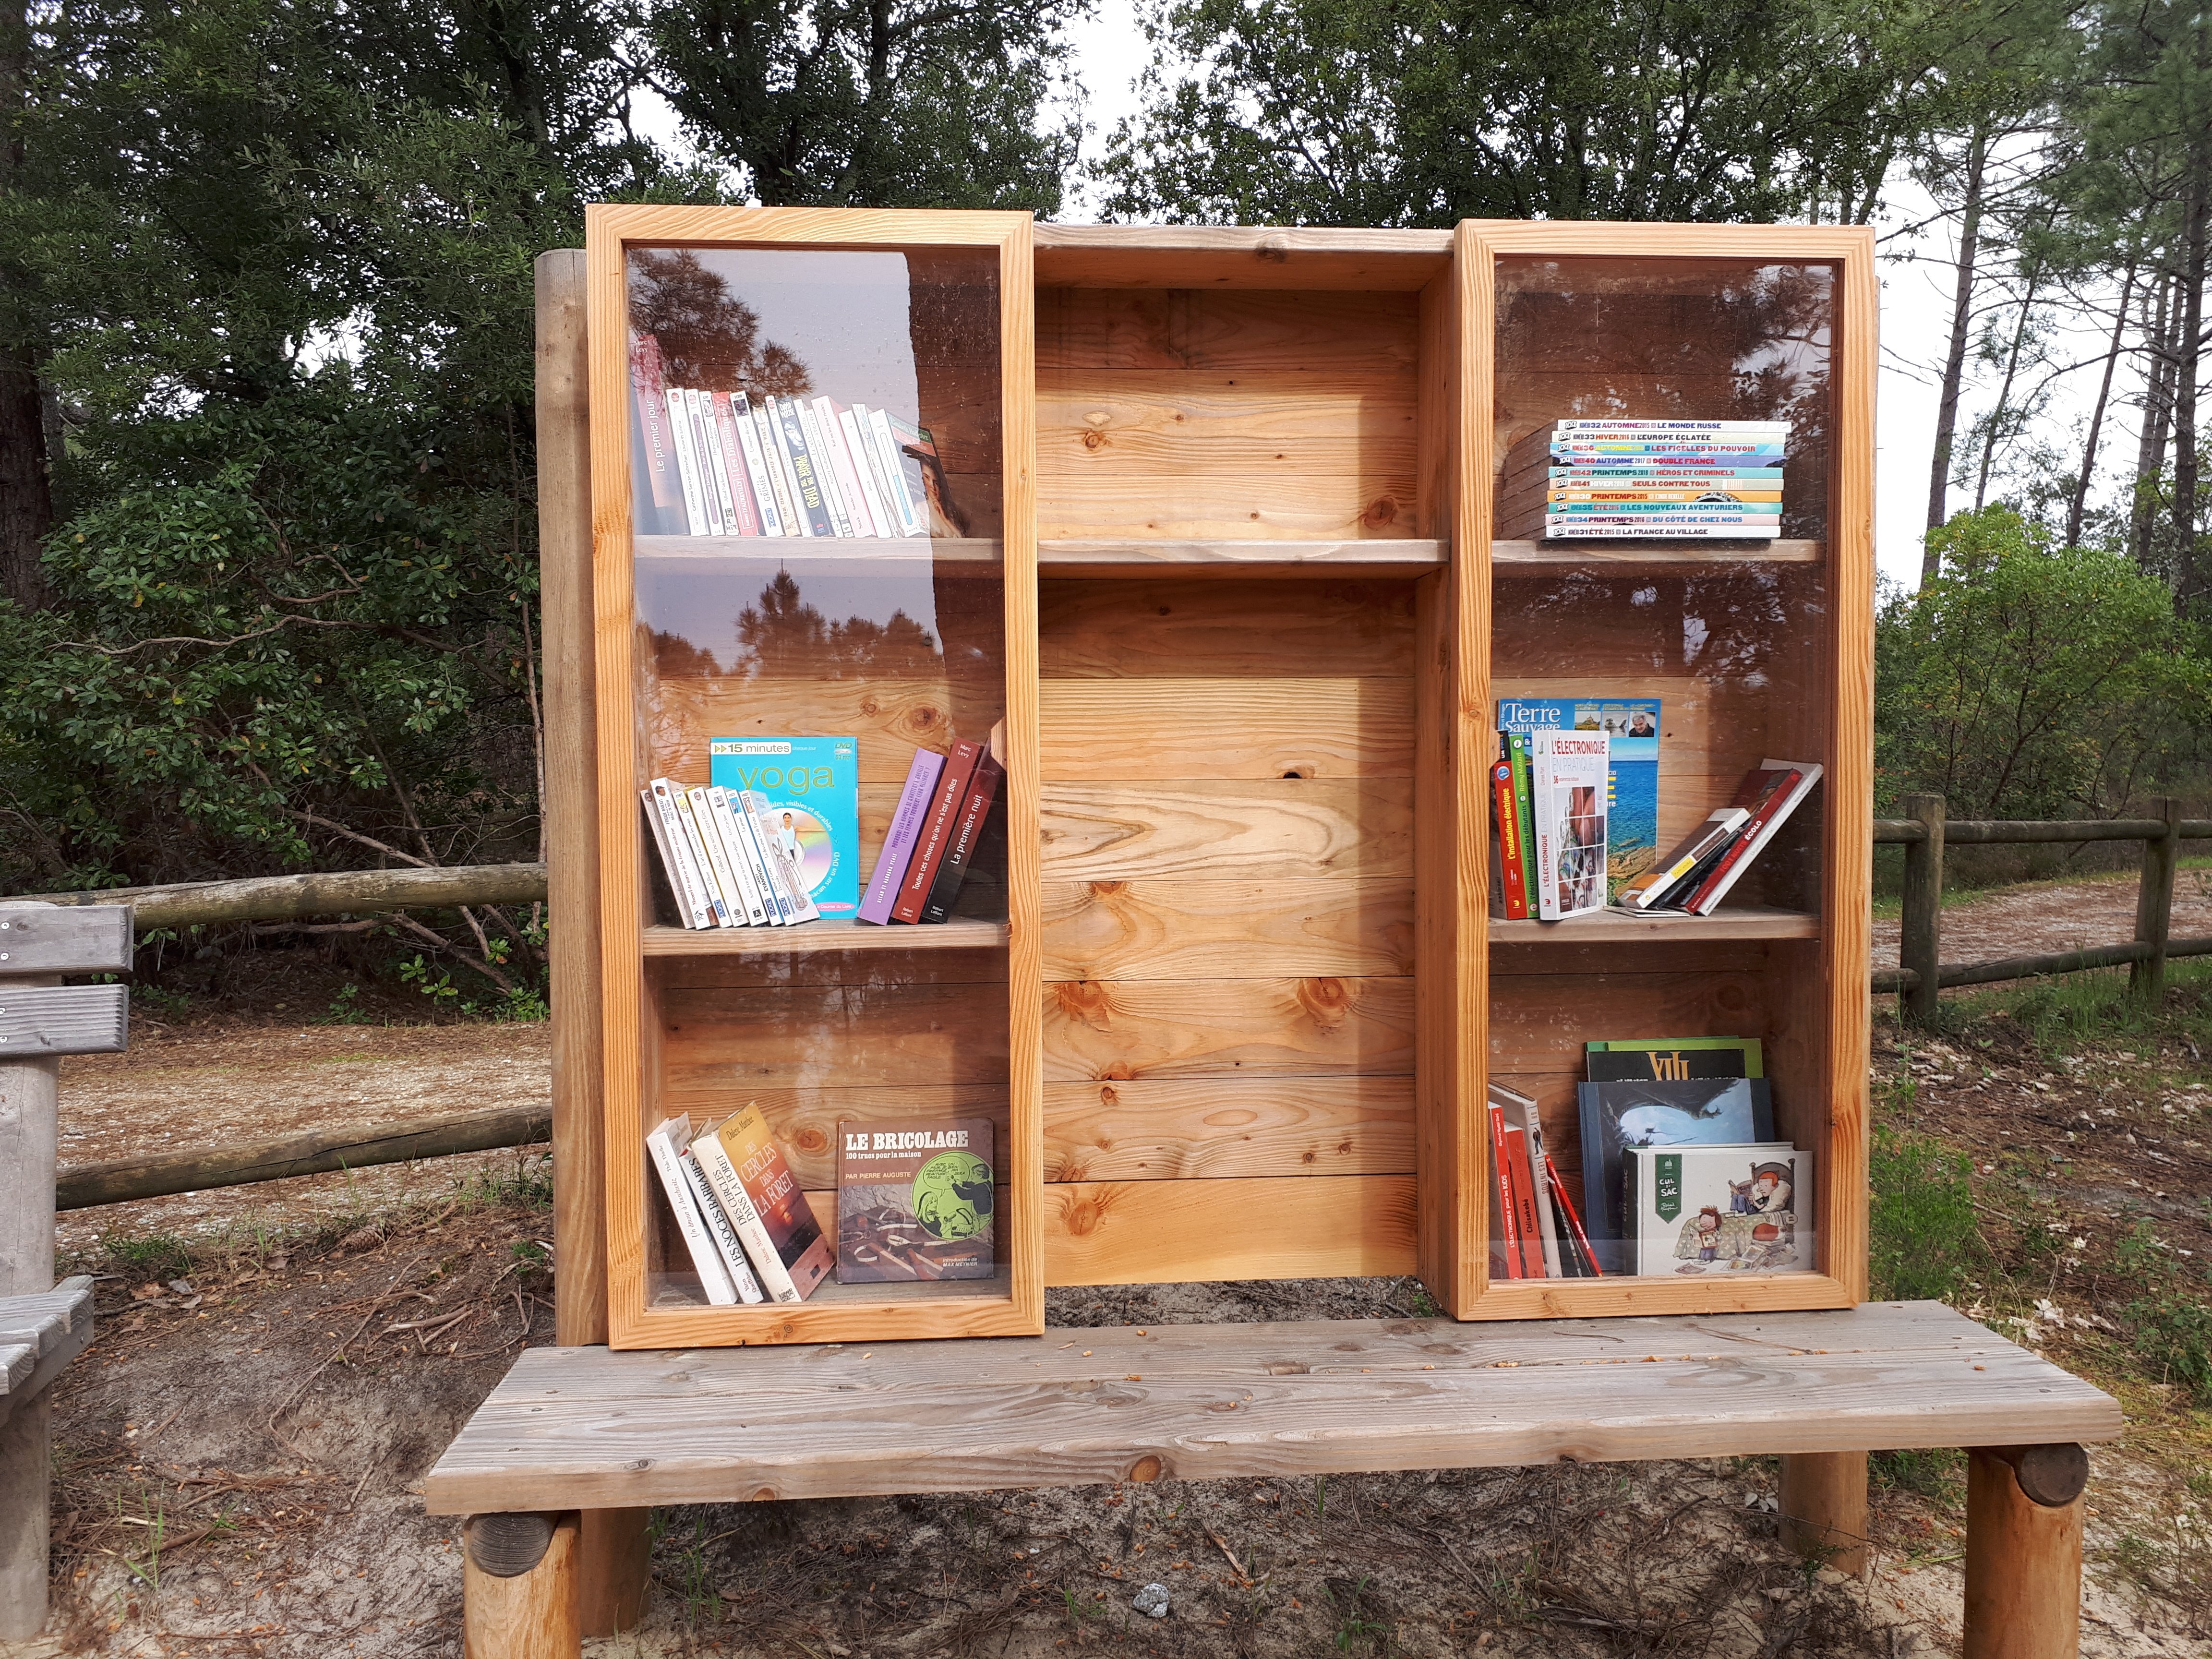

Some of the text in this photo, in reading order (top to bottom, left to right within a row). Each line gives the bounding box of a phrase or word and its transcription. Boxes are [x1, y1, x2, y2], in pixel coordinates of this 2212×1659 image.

[646, 399, 664, 472] Le premier jour
[718, 408, 739, 473] Les Diaboliques
[793, 454, 811, 479] PRAYER
[758, 475, 770, 501] GRIMES
[803, 486, 820, 508] DEAD
[1505, 703, 1561, 722] Terre
[1505, 721, 1560, 733] Sauvage
[728, 744, 789, 753] 15 minutes
[958, 750, 969, 758] Levy
[1551, 737, 1605, 754] L'ÉLECTRONIQUE
[1552, 757, 1594, 772] EN PRATIQUE
[737, 767, 835, 795] yoga
[1553, 775, 1559, 784] 36
[786, 800, 807, 810] visibles
[814, 811, 833, 831] durables
[1503, 788, 1511, 819] électrique
[912, 872, 924, 889] Toutes
[923, 842, 935, 861] choses
[931, 825, 940, 841] qu'on
[939, 803, 949, 816] s'est
[947, 778, 957, 792] dites
[950, 794, 982, 864] La première nuit
[1541, 824, 1547, 832] EN
[1720, 857, 1733, 872] 1001
[1731, 840, 1746, 857] NUITS
[1744, 820, 1762, 840] ÉCOLO
[756, 864, 768, 891] EVANOVICH
[825, 877, 833, 886] sur
[831, 867, 837, 876] un
[1526, 859, 1535, 899] l'électronique
[714, 900, 725, 918] POCKET
[766, 899, 775, 916] POCKET
[780, 898, 789, 915] POCKET
[745, 1141, 757, 1155] DES
[846, 1130, 968, 1151] LE BRICOLAGE
[741, 1142, 777, 1182] CERCLES
[715, 1154, 755, 1221] DANS LA FORET
[759, 1169, 775, 1187] DANS
[1540, 1173, 1549, 1194] INTRUS
[712, 1169, 746, 1225] DES CERCLES
[754, 1170, 793, 1217] LA FORET
[1661, 1188, 1678, 1197] SAC
[672, 1178, 699, 1238] Un amour Auschwitz
[689, 1157, 744, 1266] LES NOCES BARBARES
[1506, 1210, 1515, 1248] L'ÉLECTRONIQUE
